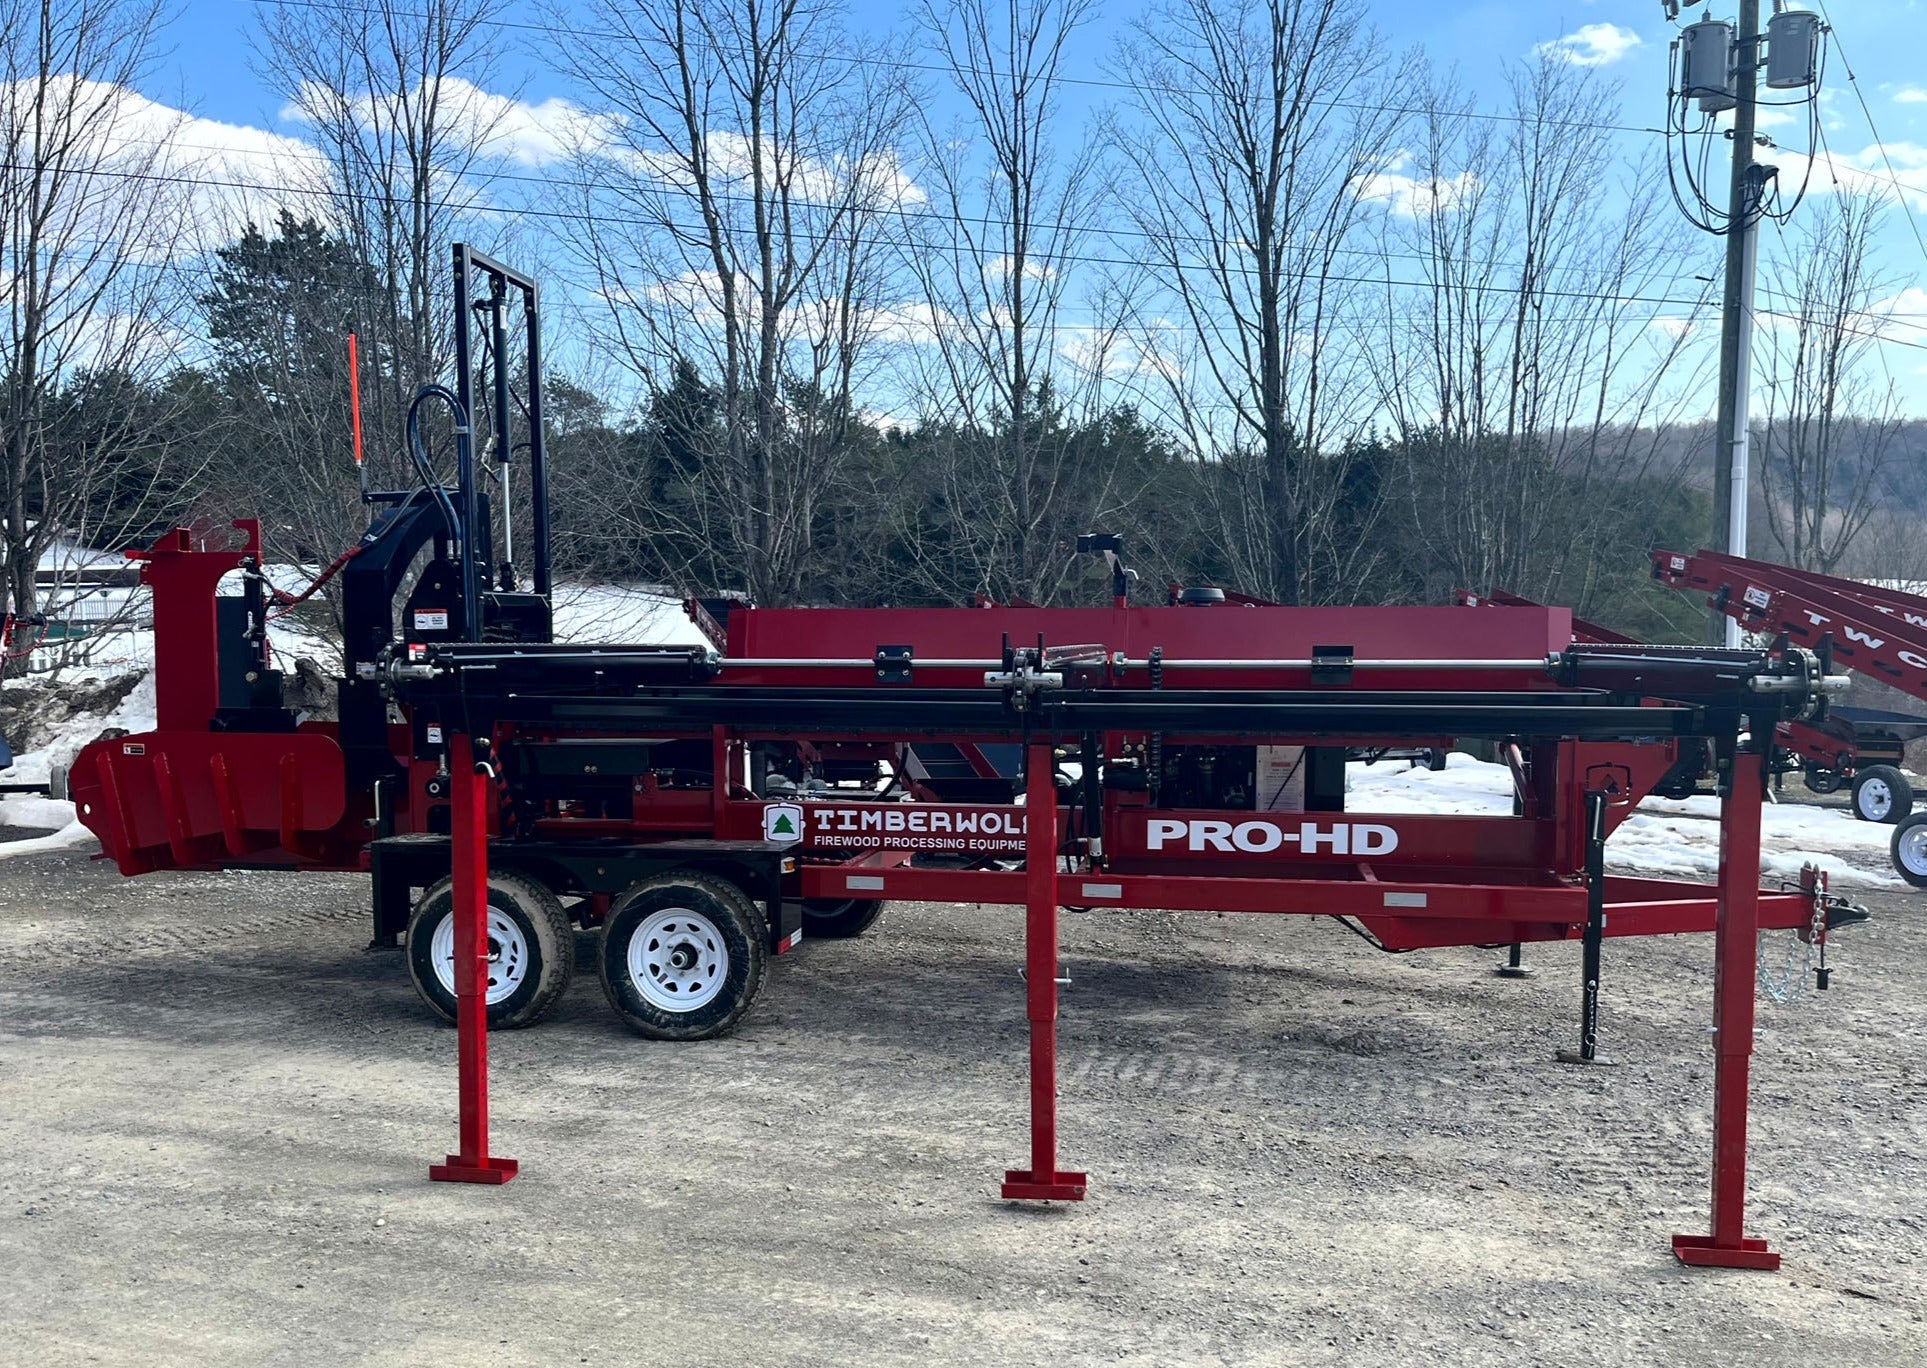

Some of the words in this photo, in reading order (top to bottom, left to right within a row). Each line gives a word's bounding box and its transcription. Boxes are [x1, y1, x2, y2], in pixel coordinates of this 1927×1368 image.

[814, 836, 880, 847] FIREWOOD
[884, 837, 965, 849] PROCESSING
[969, 839, 1027, 851] EQUIPME
[1147, 819, 1399, 855] PRO-HD
